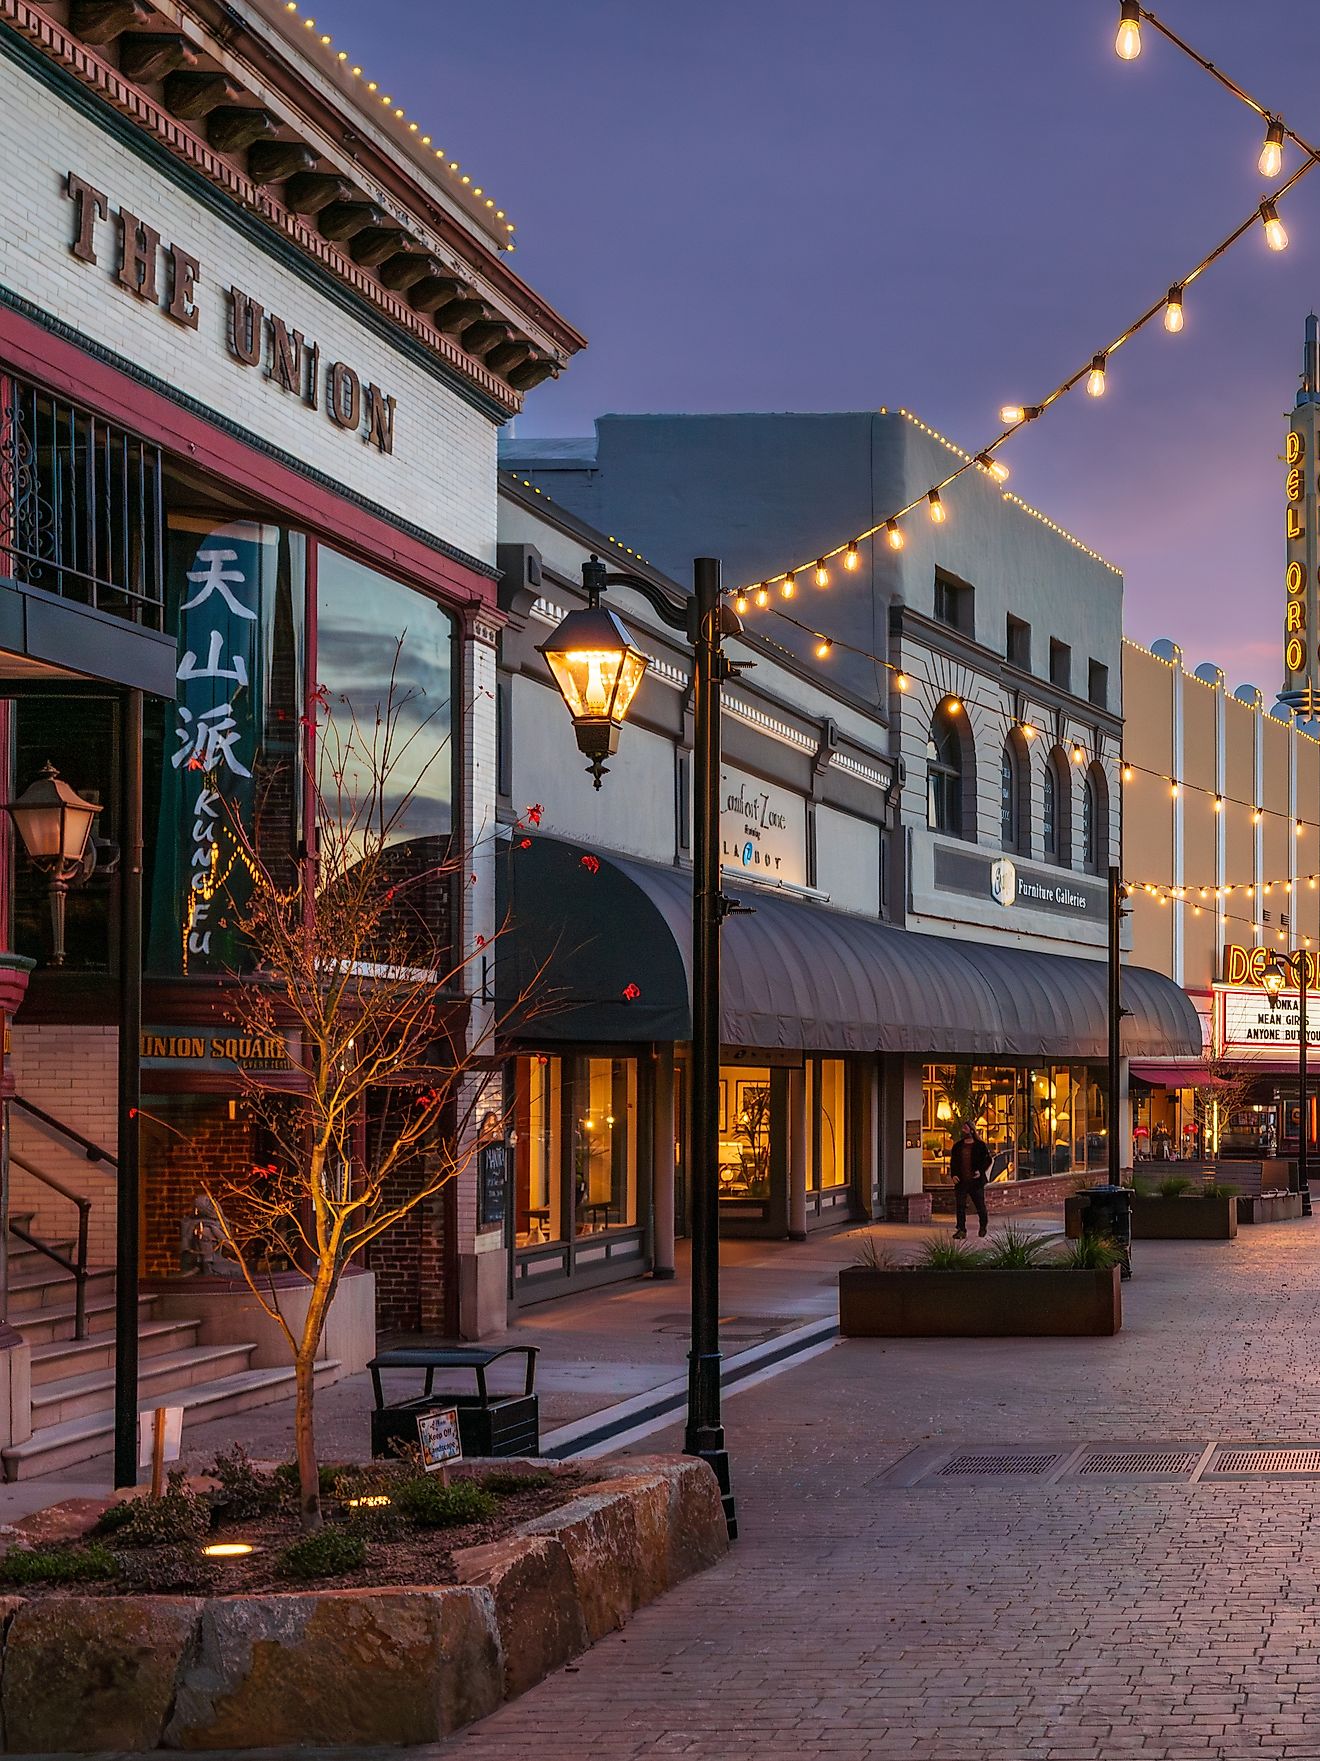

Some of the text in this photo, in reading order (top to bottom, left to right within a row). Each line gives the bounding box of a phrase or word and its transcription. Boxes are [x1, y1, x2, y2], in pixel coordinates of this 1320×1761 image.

[68, 171, 397, 456] THE UNION
[1286, 432, 1305, 672] DEL ORO
[170, 548, 258, 779] 天山派
[1018, 878, 1054, 902] Furniture
[1055, 887, 1087, 909] Galleries
[1228, 944, 1284, 986] DE
[1270, 1000, 1299, 1011] ONKA
[1286, 1015, 1310, 1027] GIRS
[139, 1036, 206, 1058] UNION
[1246, 1028, 1280, 1041] ANYONE
